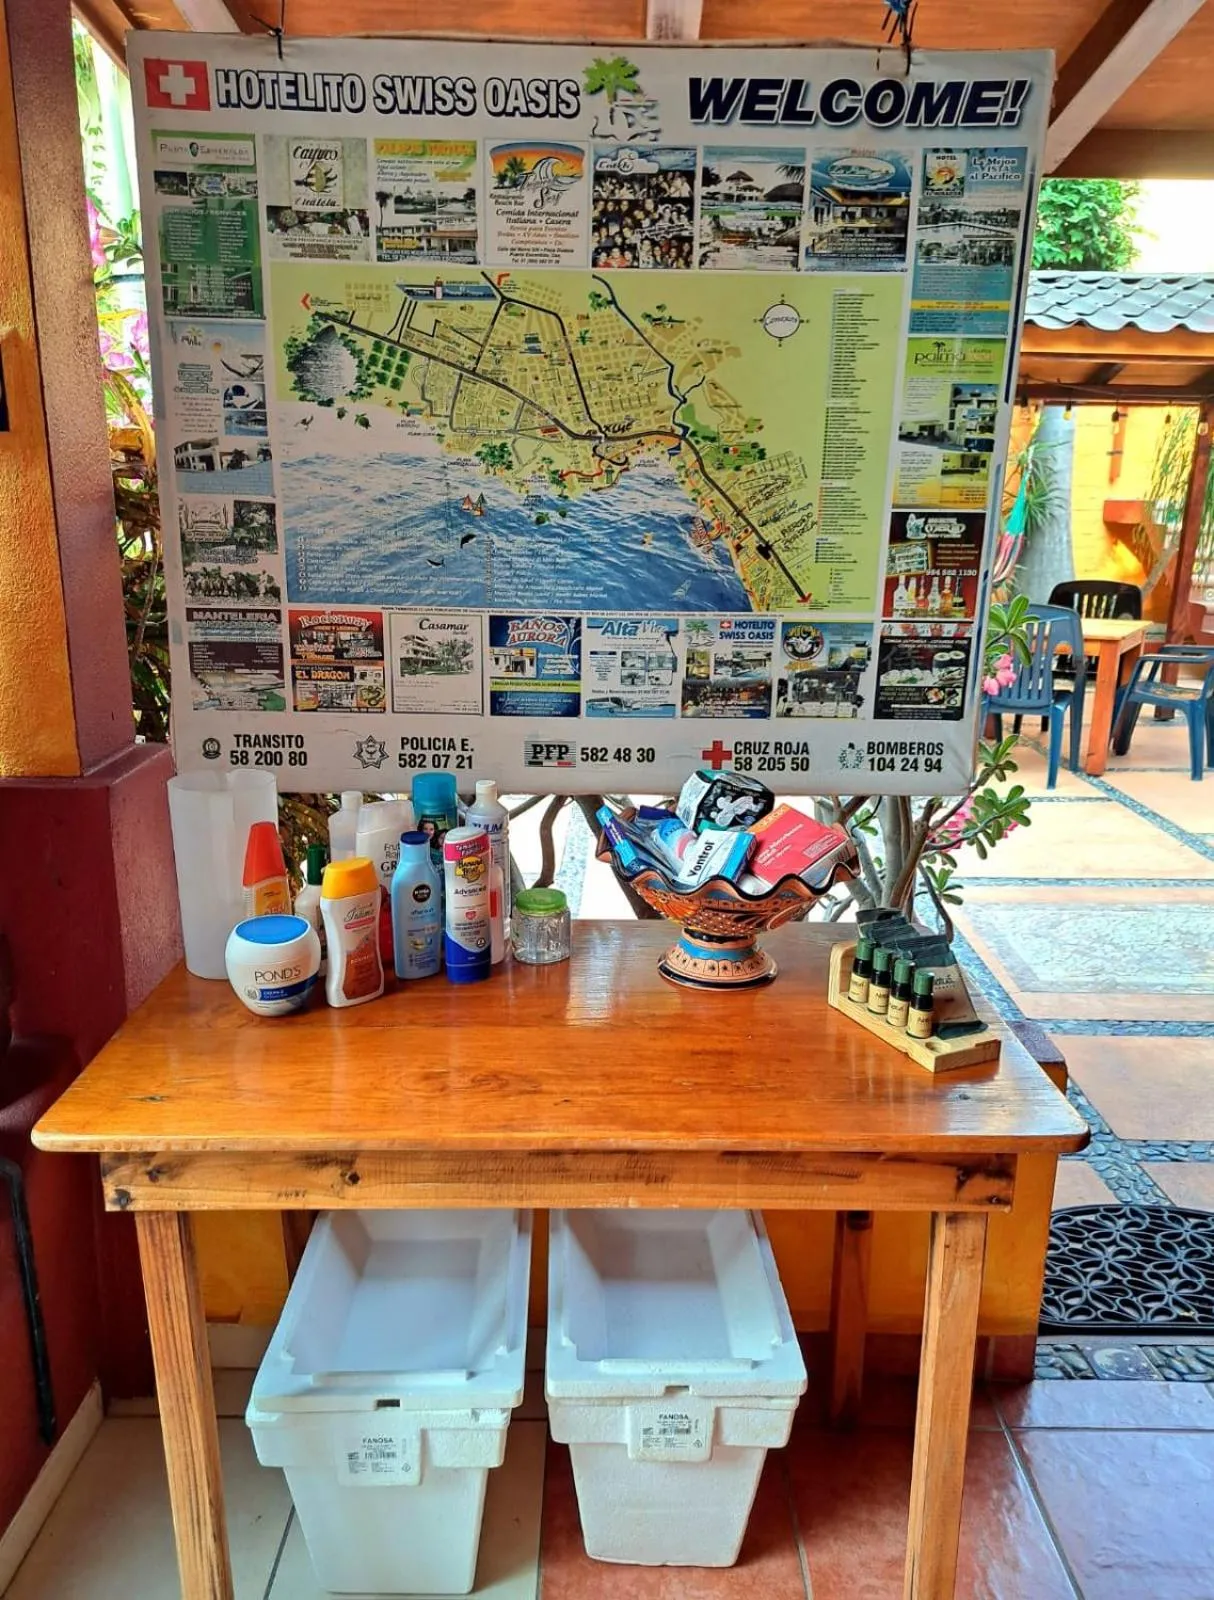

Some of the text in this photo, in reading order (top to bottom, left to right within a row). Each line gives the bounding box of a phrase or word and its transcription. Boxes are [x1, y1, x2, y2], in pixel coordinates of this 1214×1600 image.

[215, 68, 581, 119] HOTELITO SWISS OASIS
[688, 76, 1030, 129] WELCOME!
[496, 208, 579, 219] Comida Internacional
[506, 217, 571, 226] Italiana Casera
[419, 618, 469, 631] Casamar
[734, 620, 775, 631] HOTELITO
[507, 631, 566, 647] AURORA
[719, 631, 774, 641] SWISS OASIS
[295, 670, 310, 680] EL
[234, 734, 305, 750] TRANSITO
[400, 737, 475, 752] POLICIA E.
[733, 741, 810, 756] CRUZ ROJA
[866, 742, 944, 756] BOMBEROS
[230, 750, 308, 767] 58 200 80
[398, 753, 474, 770] 582 07 21
[531, 744, 656, 764] PFP 582 48 30
[733, 757, 810, 772] 58 205 50
[868, 757, 944, 773] 104 24 94
[687, 841, 716, 878] Vontrol
